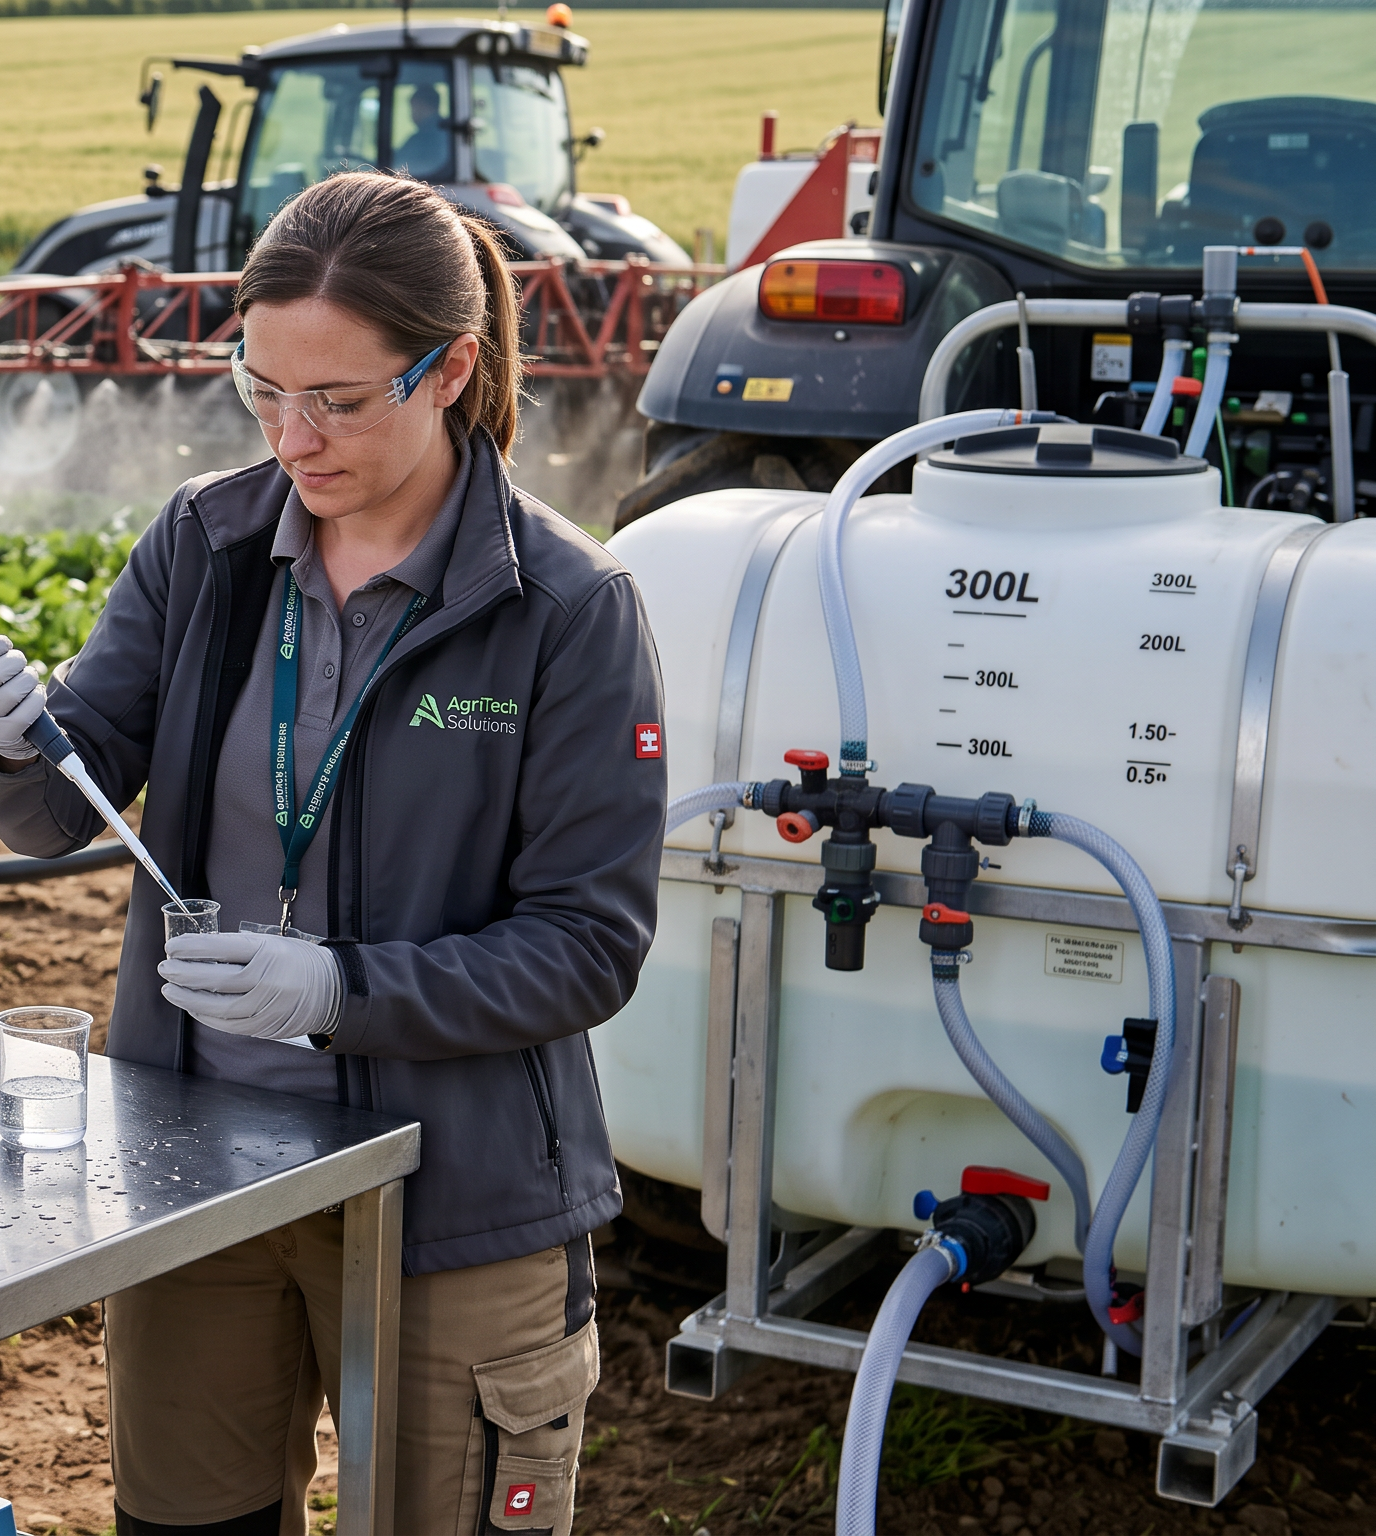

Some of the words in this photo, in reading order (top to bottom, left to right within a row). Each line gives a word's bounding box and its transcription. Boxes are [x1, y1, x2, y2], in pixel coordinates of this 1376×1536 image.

[945, 569, 1039, 603] 300L
[1151, 572, 1197, 589] 300L
[1139, 633, 1186, 652] 200L
[974, 670, 1019, 689] 300L
[446, 696, 518, 716] AgriTech
[446, 714, 517, 735] Solutions
[968, 738, 1013, 758] 300L
